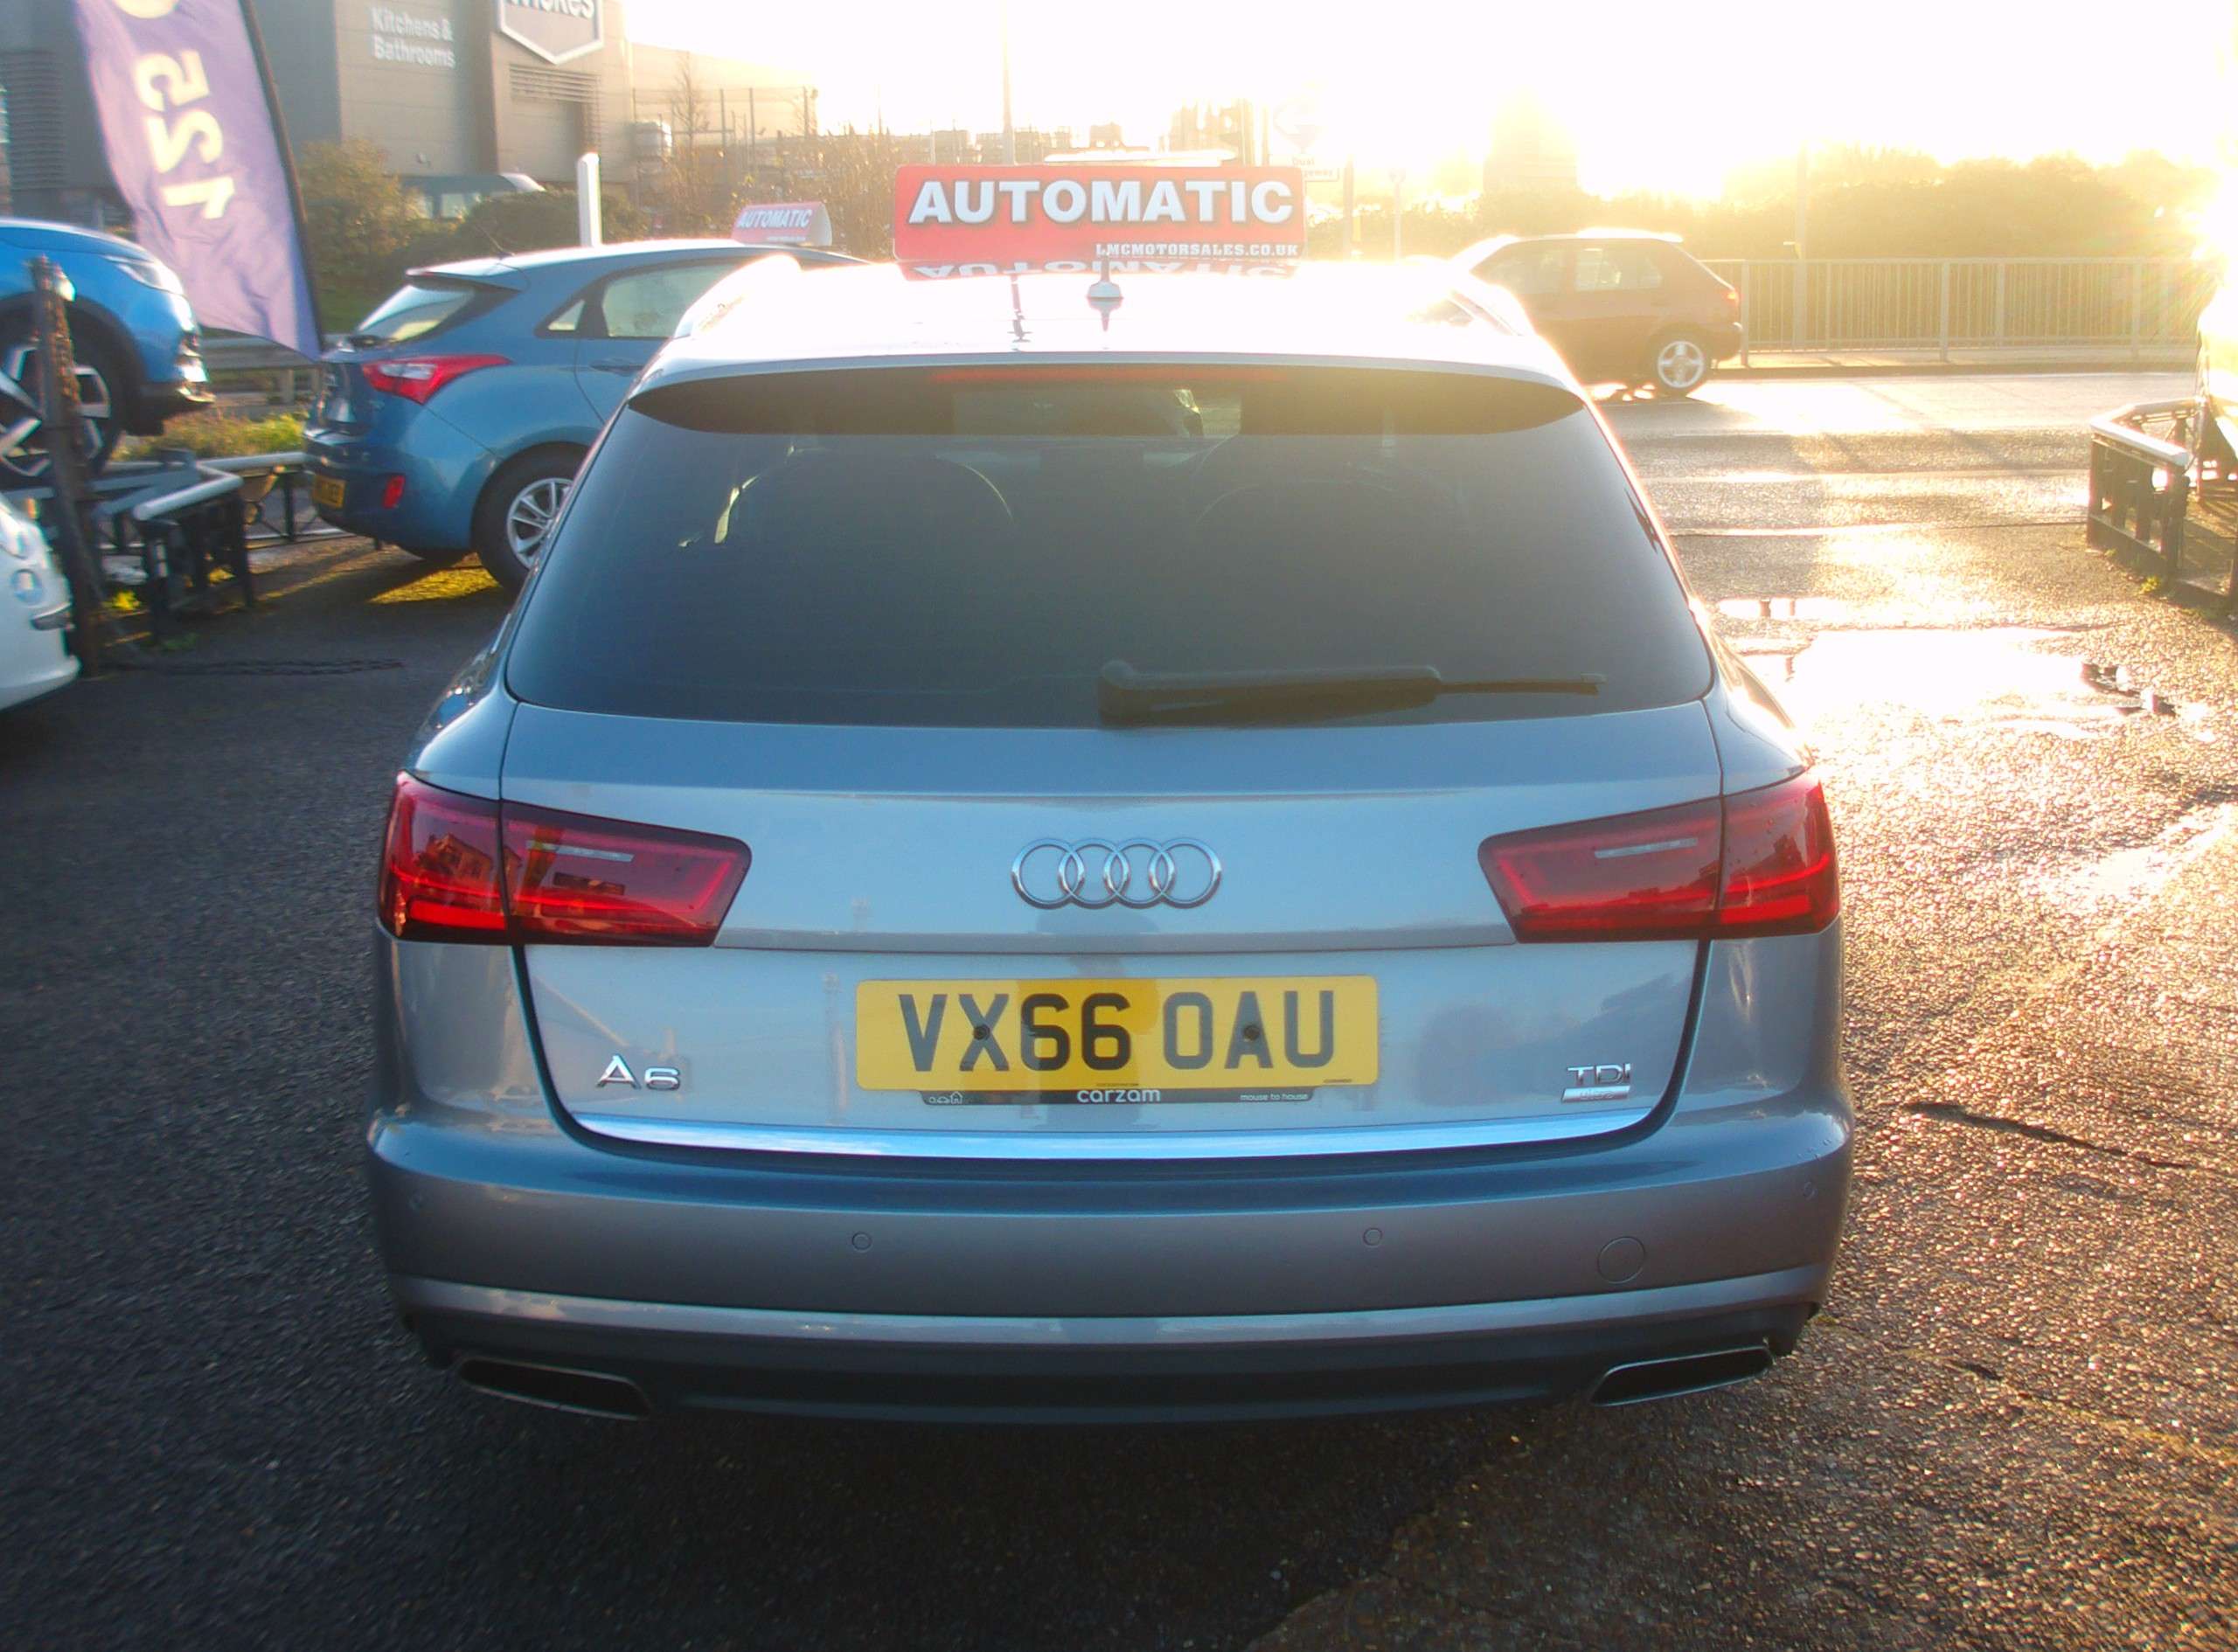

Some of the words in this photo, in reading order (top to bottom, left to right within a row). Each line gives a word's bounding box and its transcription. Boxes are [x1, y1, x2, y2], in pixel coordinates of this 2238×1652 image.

[371, 7, 439, 40] Kitchens
[441, 17, 453, 42] &
[373, 34, 455, 69] Bathrooms
[736, 209, 812, 229] AUTOMATIC
[908, 180, 1294, 224] AUTOMATIC
[1095, 243, 1299, 256] LMCMOTORSALES.CO.UK
[898, 992, 1132, 1072] VX66
[1163, 990, 1335, 1070] OAU
[596, 1054, 680, 1090] A6
[1567, 1063, 1632, 1085] TDI
[1076, 1089, 1161, 1103] carzam
